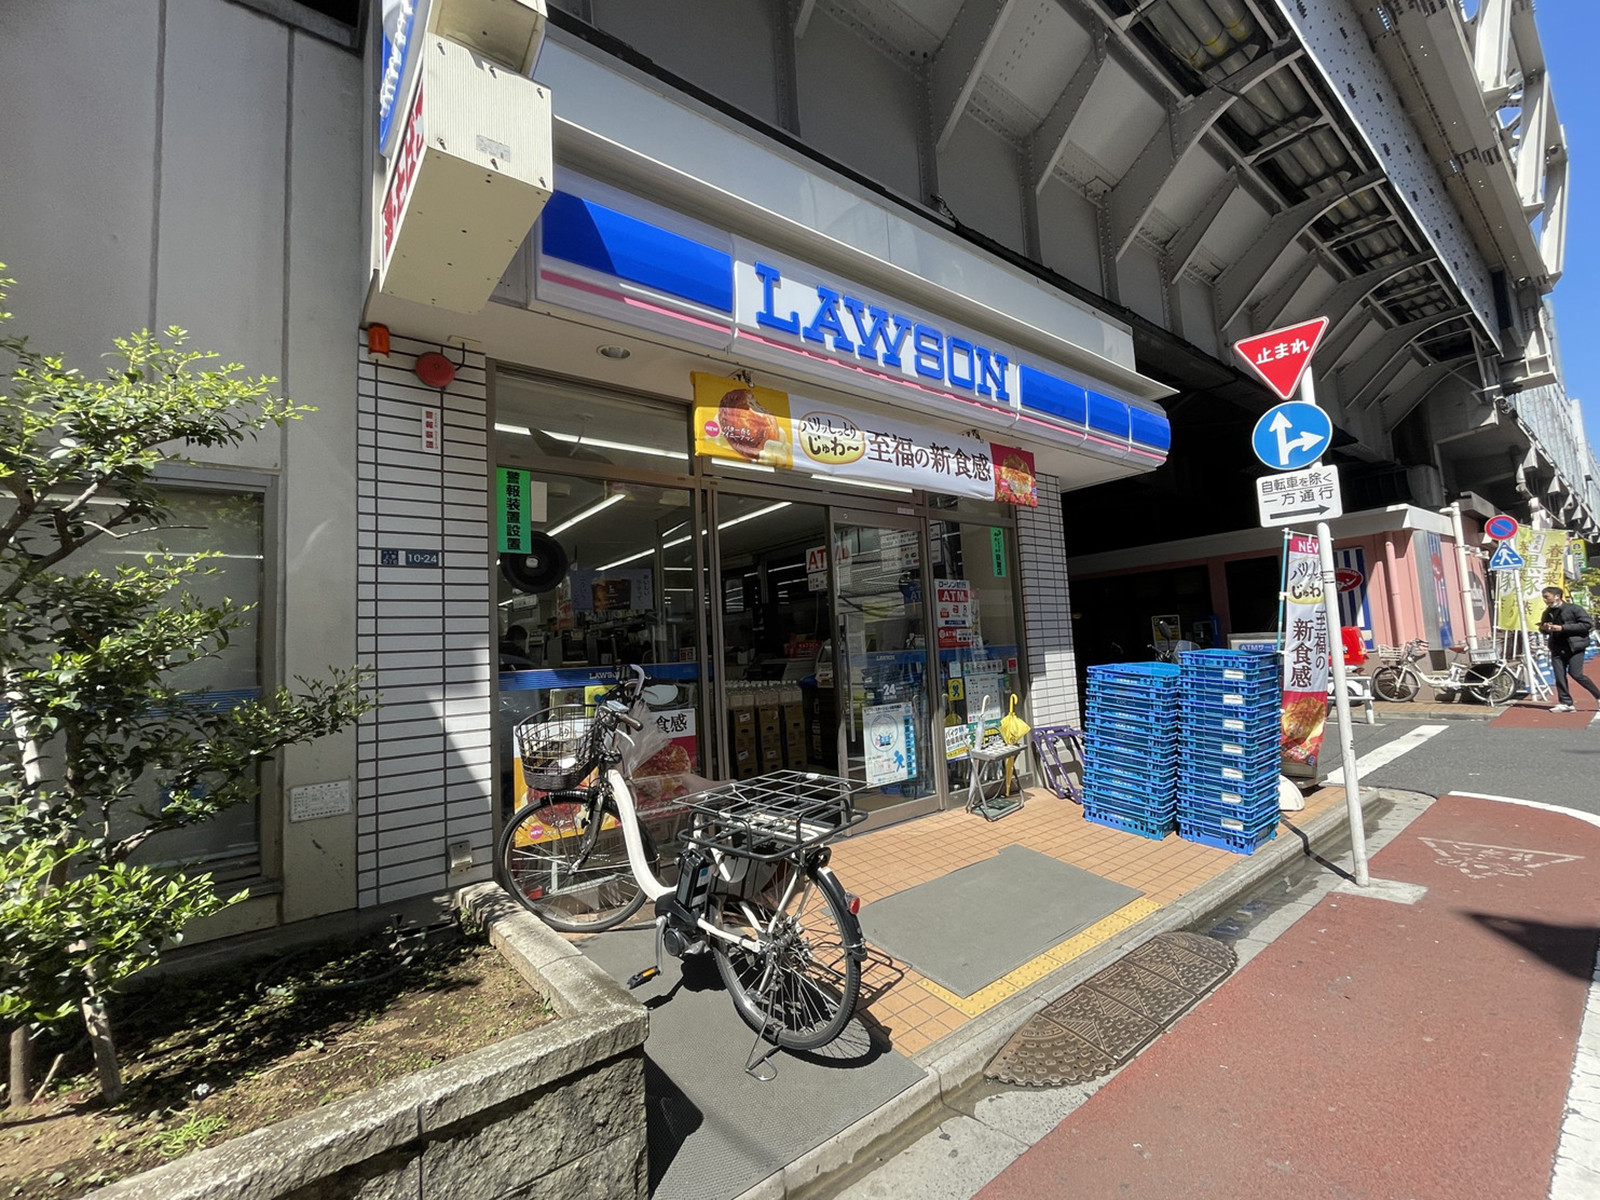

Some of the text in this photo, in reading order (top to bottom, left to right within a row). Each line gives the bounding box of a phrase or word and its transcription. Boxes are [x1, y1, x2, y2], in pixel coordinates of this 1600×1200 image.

[754, 261, 1010, 401] LAWSON
[1255, 338, 1310, 365] 止まれ
[866, 429, 993, 482] 至福の新食感
[1261, 472, 1333, 494] 自転車を除く
[1263, 485, 1334, 506] 一方通行
[506, 470, 521, 551] 警報装置設置
[407, 553, 437, 563] 10-24
[942, 590, 965, 602] ATM
[1291, 582, 1324, 599] じゅわ
[1290, 618, 1314, 688] 新食感
[882, 683, 897, 696] 24
[656, 713, 688, 734] 食感
